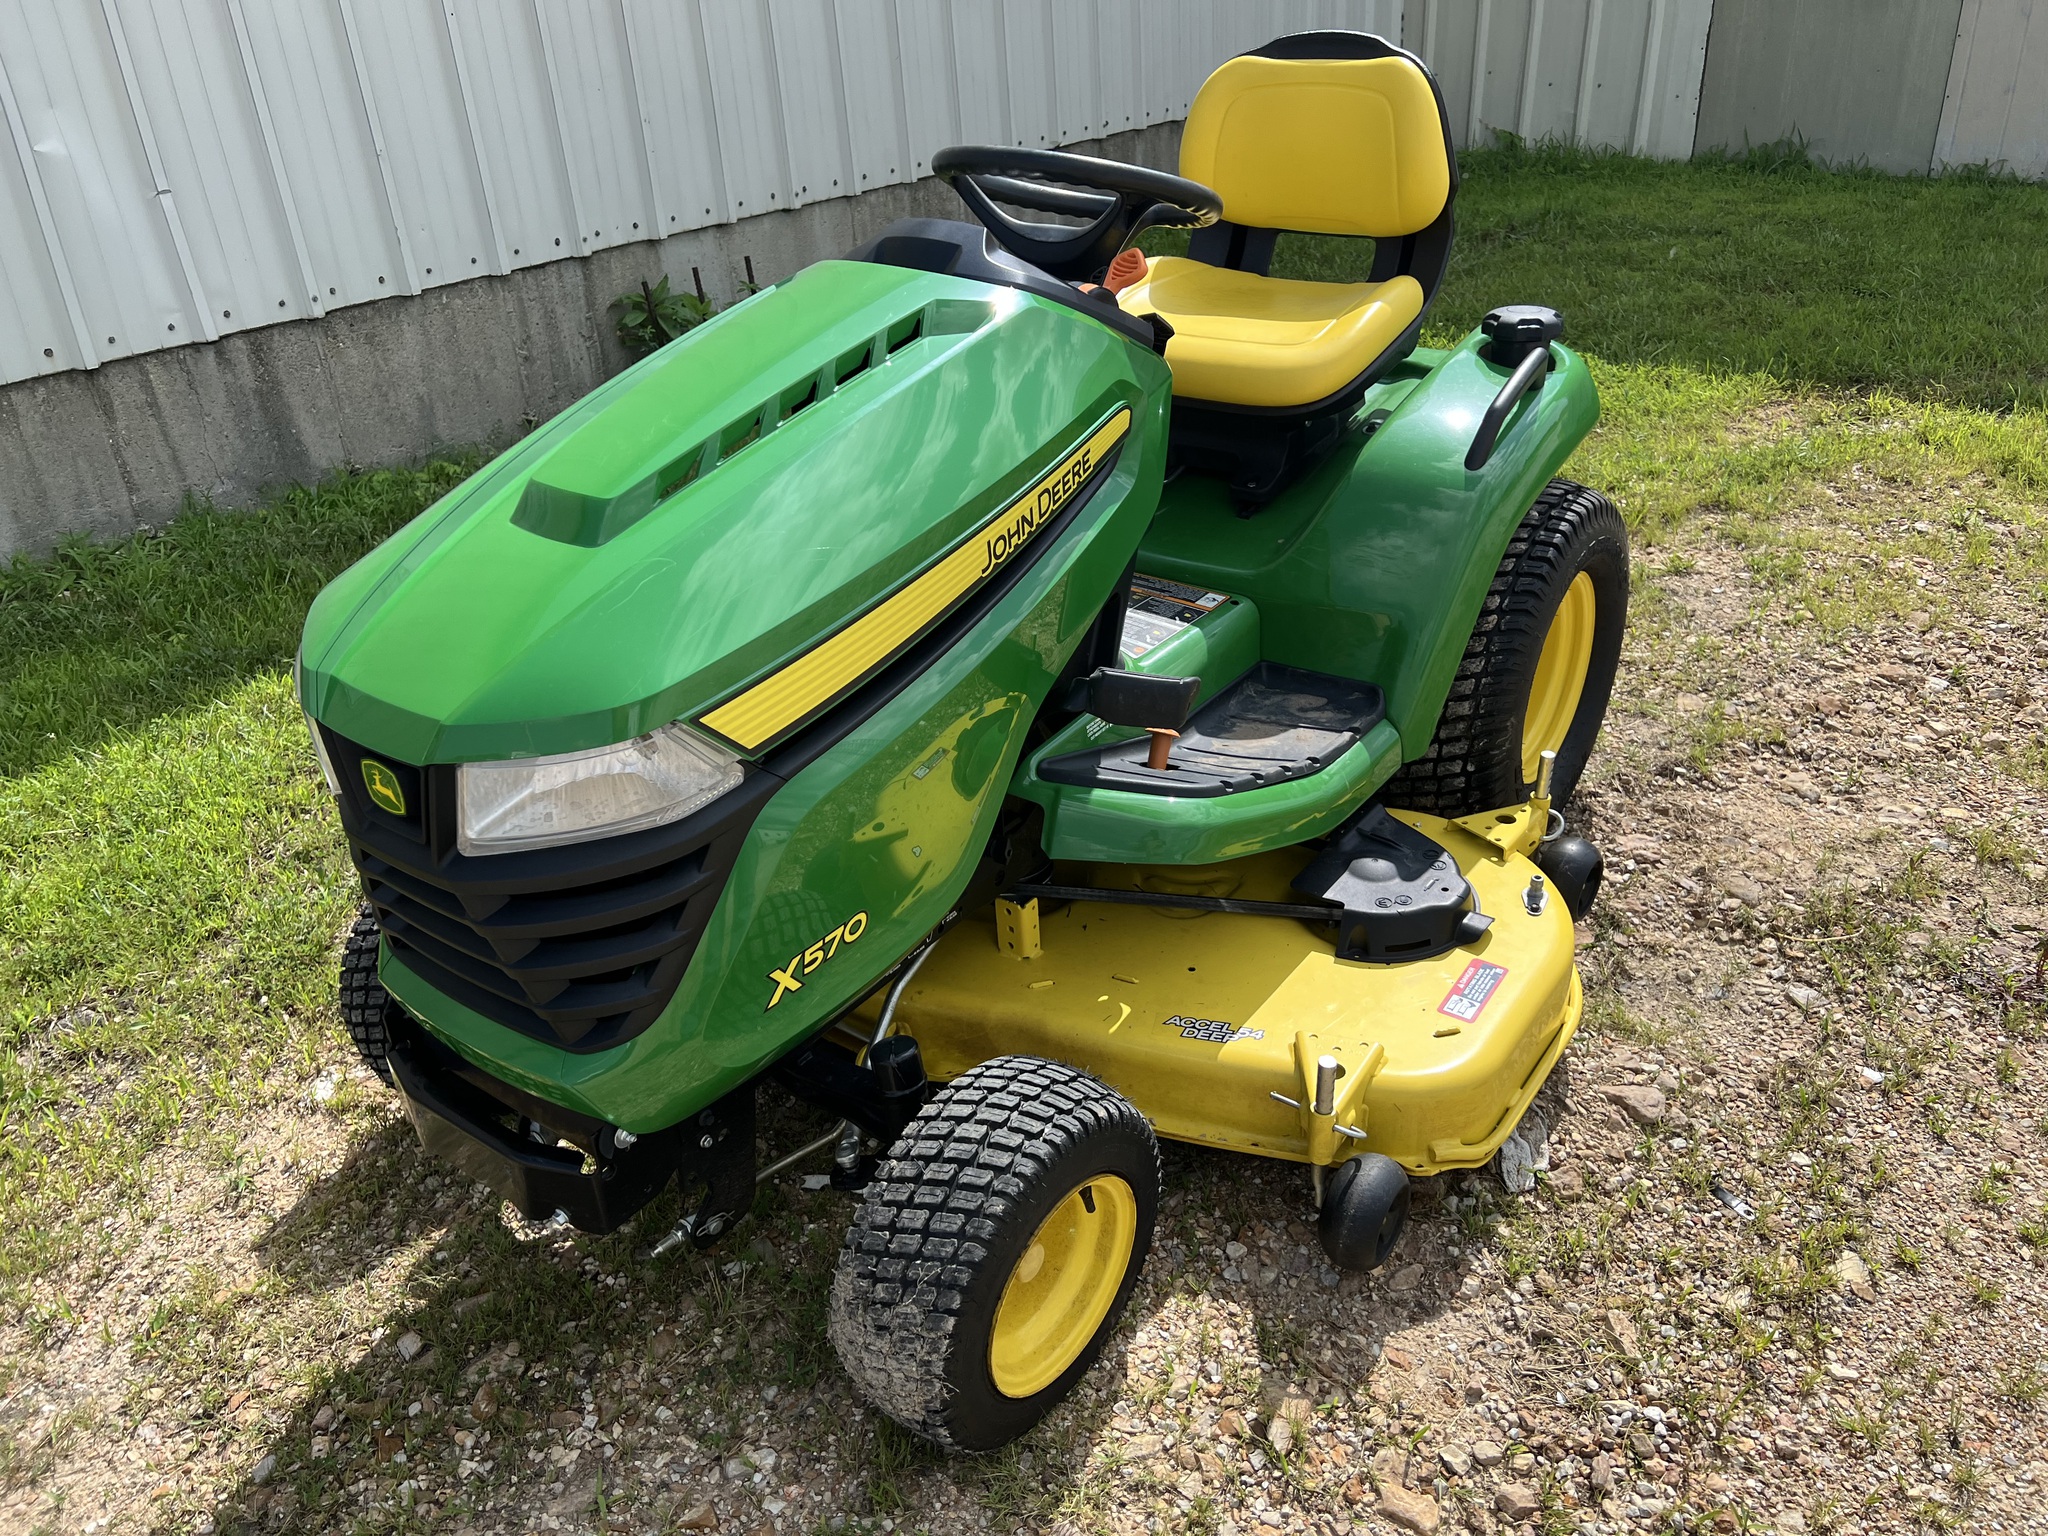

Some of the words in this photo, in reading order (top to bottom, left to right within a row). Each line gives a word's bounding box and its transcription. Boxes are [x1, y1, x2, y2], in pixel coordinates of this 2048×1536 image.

[981, 506, 1035, 576] JOHN
[1037, 447, 1093, 522] DEERE
[764, 910, 869, 1013] X570
[1459, 967, 1476, 986] DANGER
[1162, 1015, 1235, 1034] ACCEL
[1180, 1027, 1240, 1043] DEEP
[1235, 1026, 1265, 1041] 54
